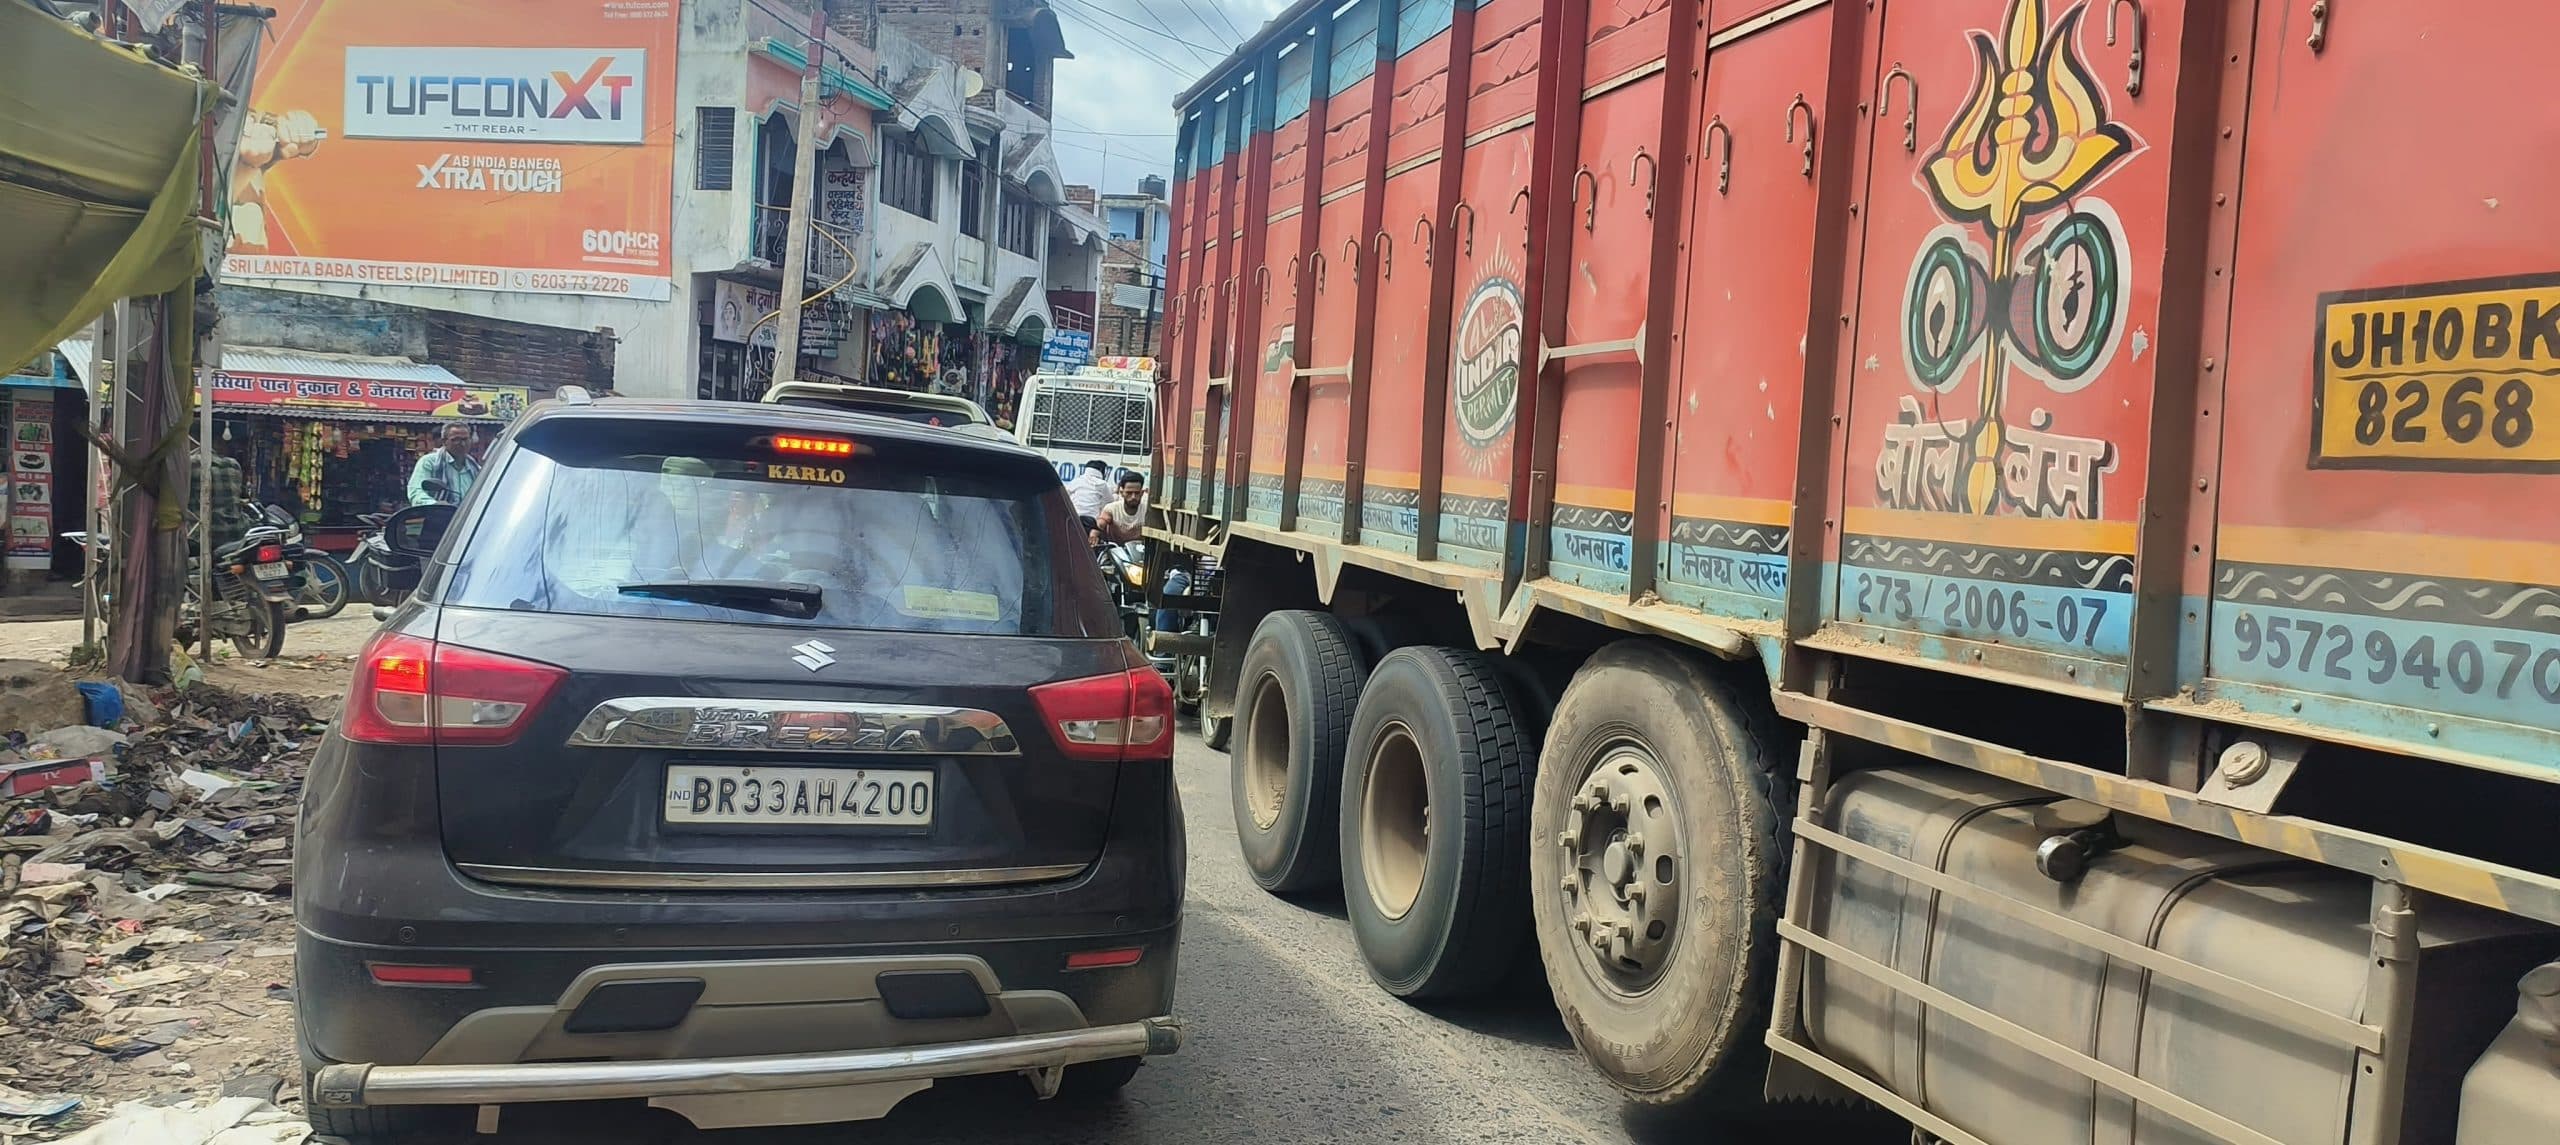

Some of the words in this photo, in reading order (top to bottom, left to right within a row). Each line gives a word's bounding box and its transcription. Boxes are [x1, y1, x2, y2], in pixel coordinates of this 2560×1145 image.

[455, 124, 478, 133] TMT
[482, 125, 525, 135] REBAR
[416, 154, 486, 191] XTRA
[490, 169, 561, 193] TOUGH
[473, 156, 507, 169] INDIA
[509, 158, 561, 170] BANEGA
[229, 258, 251, 274] SRI
[254, 260, 311, 276] LANGTA
[314, 263, 354, 278] BABA
[358, 266, 412, 281] STEELS
[440, 270, 499, 286] LIMITED
[531, 274, 567, 289] 6203
[572, 276, 588, 290] 73
[592, 278, 629, 293] 2226
[260, 379, 290, 392] पान
[296, 380, 340, 397] दुकान
[348, 383, 362, 396] &
[368, 381, 417, 399] जेनरल
[421, 382, 452, 400] स्टोर
[2355, 376, 2534, 448] 8268
[768, 464, 846, 484] KARLO
[686, 723, 928, 753] BREZZA
[669, 790, 691, 801] IND
[691, 777, 930, 816] BR33AH4200
